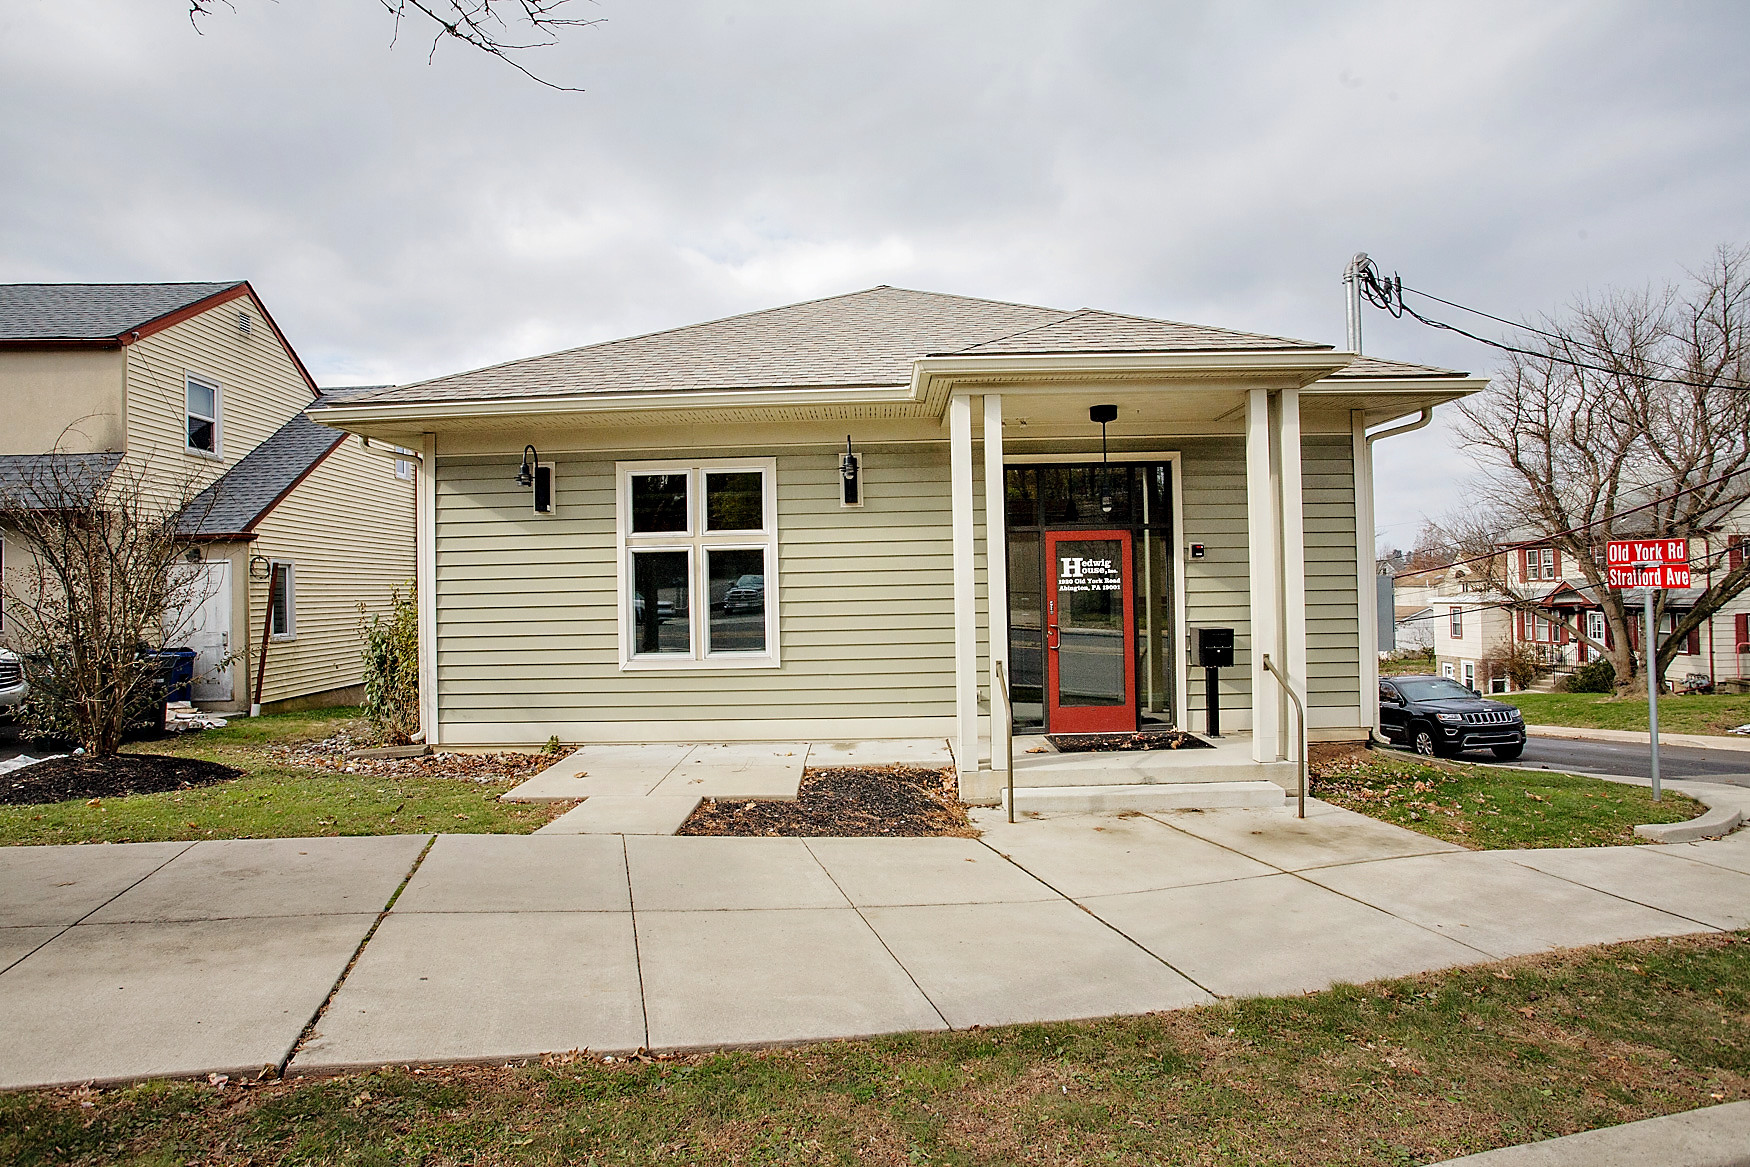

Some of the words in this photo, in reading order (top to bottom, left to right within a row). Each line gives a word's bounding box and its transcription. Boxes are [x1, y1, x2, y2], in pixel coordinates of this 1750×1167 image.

[1609, 544, 1629, 562] Old
[1634, 543, 1662, 561] York
[1667, 542, 1683, 559] Rd
[1061, 558, 1111, 577] Hedwig
[1609, 567, 1661, 586] Stratford
[1666, 567, 1689, 586] Ave
